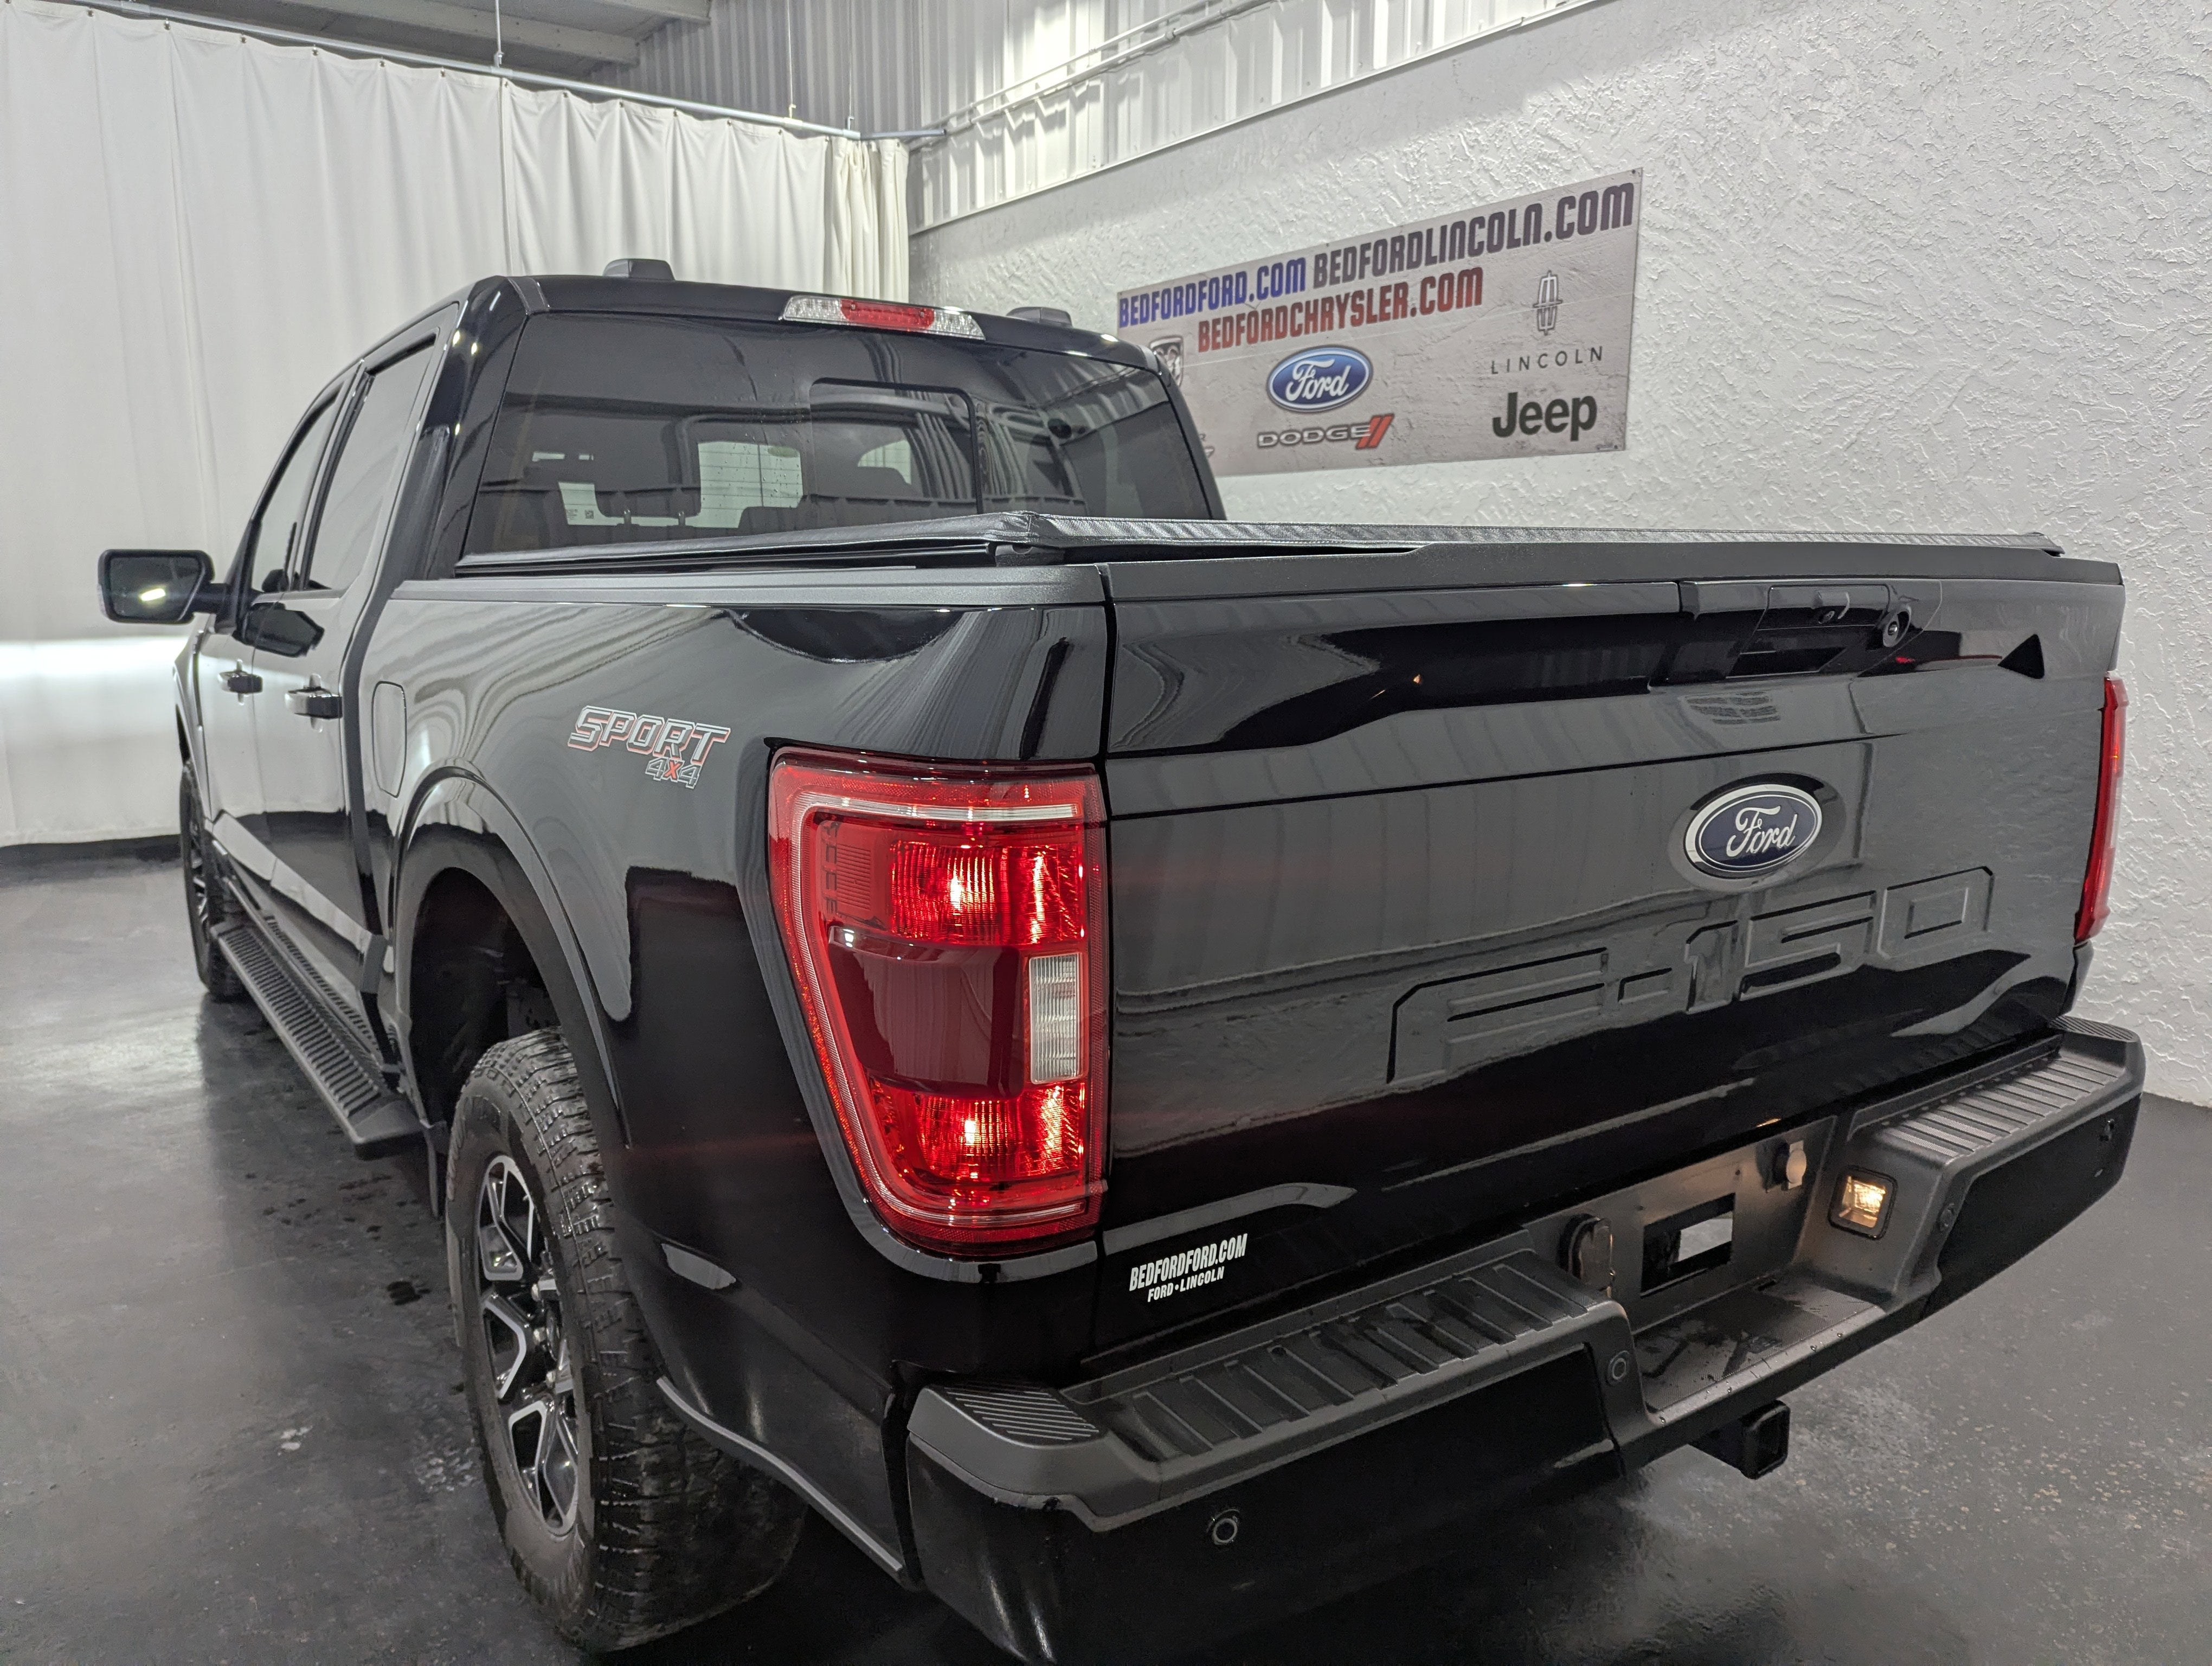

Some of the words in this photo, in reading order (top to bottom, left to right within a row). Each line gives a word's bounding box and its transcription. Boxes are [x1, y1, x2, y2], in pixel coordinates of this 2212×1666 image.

[1119, 257, 1306, 328] BEDFORDFORD.COM
[1313, 182, 1634, 289] BEDFORDLINCOLN.COM
[1198, 266, 1483, 353] BEDFORDCHRYSLER.COM
[1285, 358, 1350, 401] Ford
[1491, 345, 1603, 374] LINCOLN
[1257, 422, 1372, 449] DODGE
[1492, 392, 1597, 442] Jeep
[568, 705, 731, 766] SPORT
[1726, 805, 1798, 857] Ford
[1386, 866, 1994, 1085] F-150
[1129, 1233, 1248, 1291] BEDFORDFORD.COM
